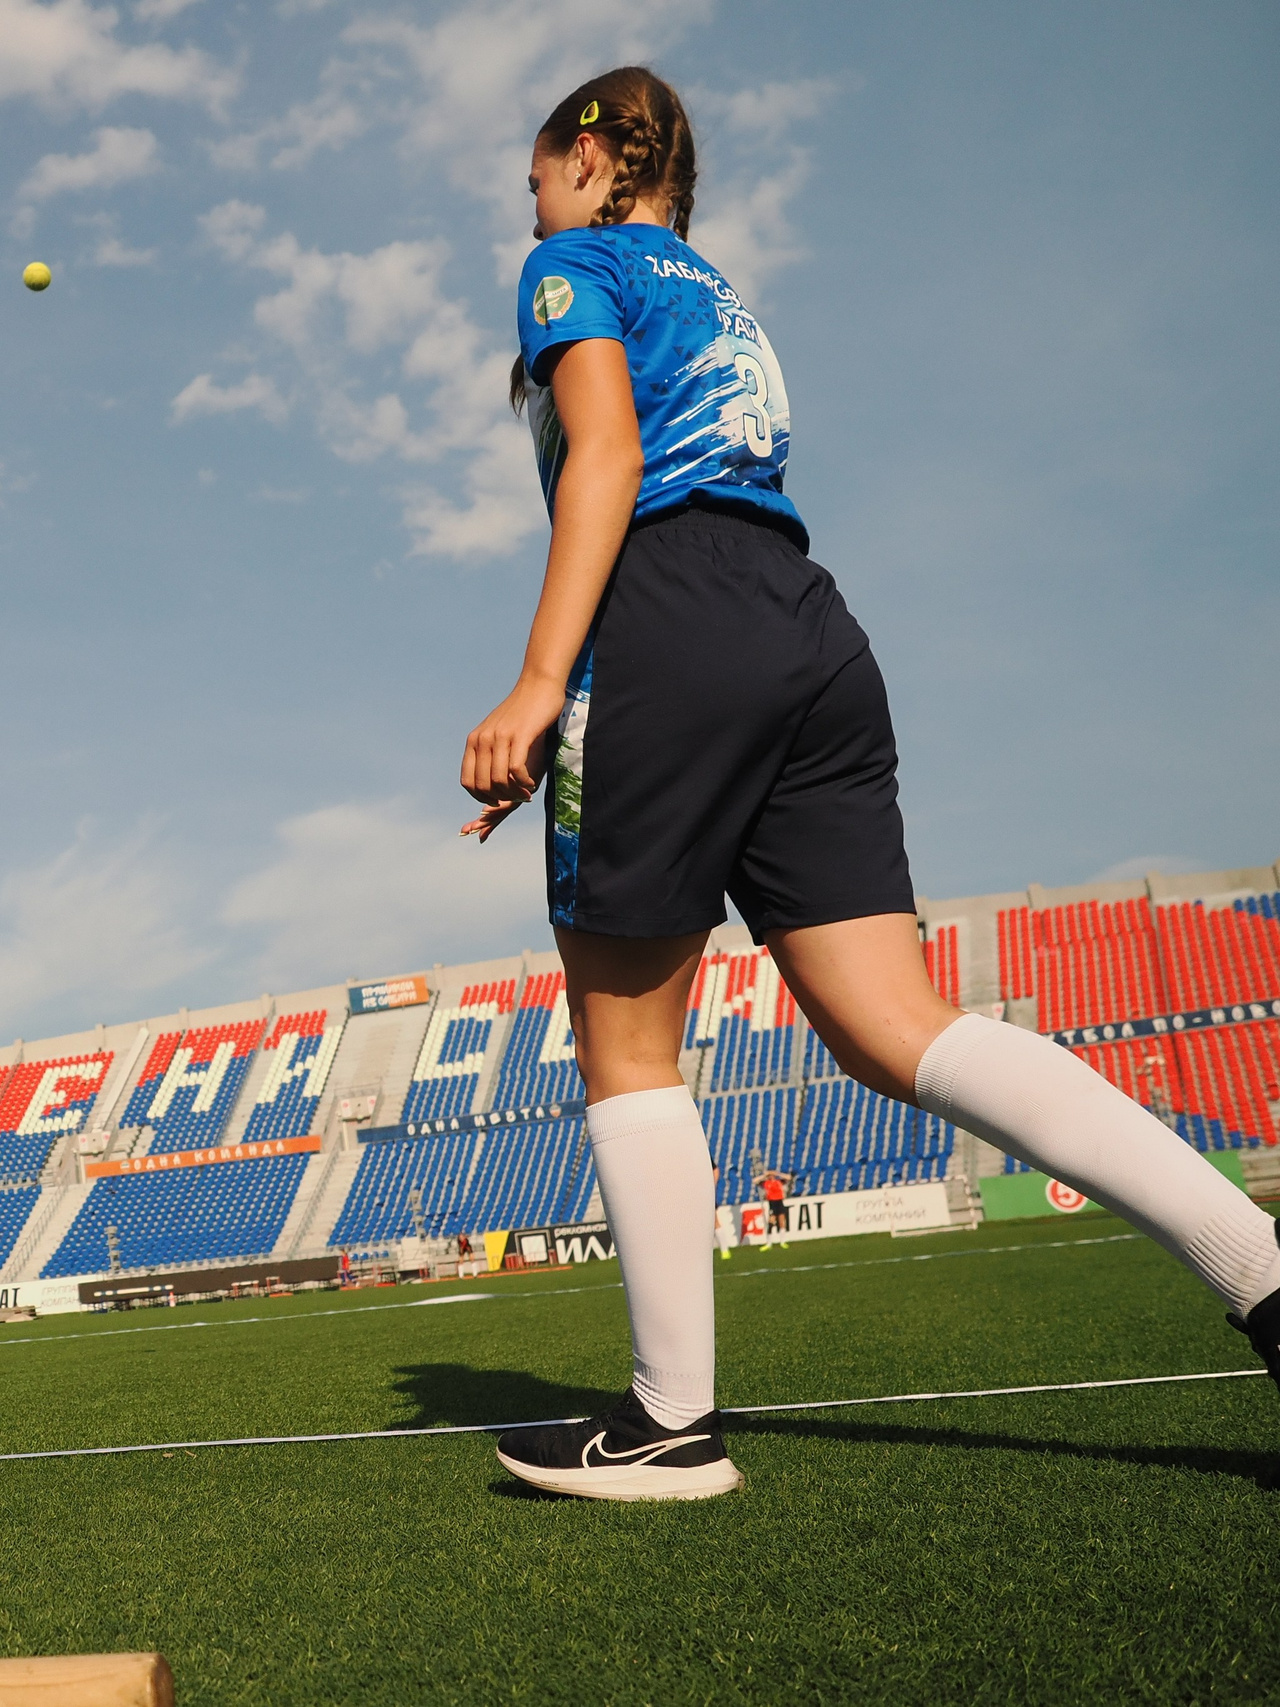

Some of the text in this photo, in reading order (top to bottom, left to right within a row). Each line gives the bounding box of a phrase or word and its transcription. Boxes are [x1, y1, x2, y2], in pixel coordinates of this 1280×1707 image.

[734, 353, 773, 458] 3
[1044, 1022, 1135, 1045] УТБОЛ
[407, 1117, 460, 1136] ОДНА
[133, 1141, 285, 1170] ОДНА КОМАНДА
